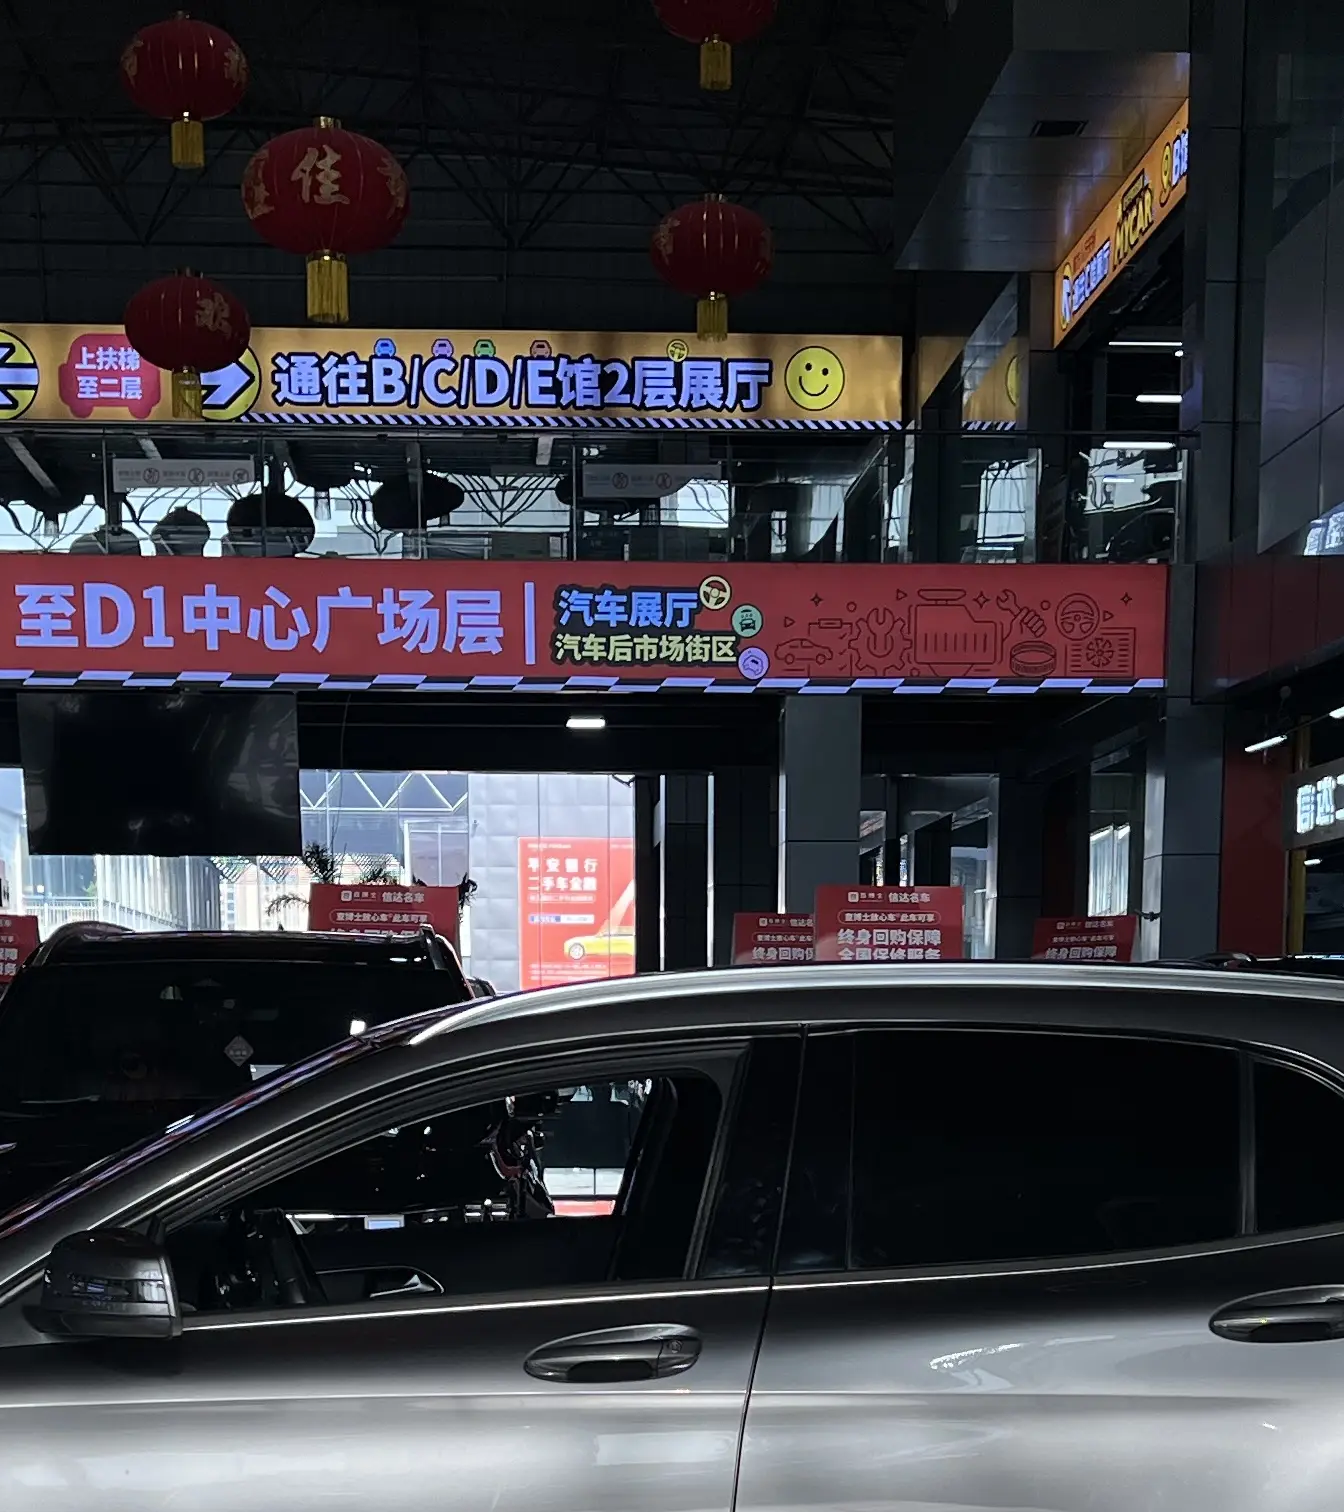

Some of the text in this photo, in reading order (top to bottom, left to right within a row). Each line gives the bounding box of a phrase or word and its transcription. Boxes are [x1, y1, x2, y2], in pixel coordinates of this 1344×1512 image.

[75, 347, 141, 371] 上扶梯
[76, 376, 143, 400] 至二层
[274, 355, 770, 409] 通往B/C/D/E馆2层展厅
[16, 582, 505, 655] 至D1中心广场层
[558, 590, 700, 628] 汽车展厅
[555, 634, 738, 664] 汽车后市场街区
[382, 891, 425, 903] 信达名车
[888, 892, 931, 902] 信达名车
[836, 928, 942, 946] 终身回购保障
